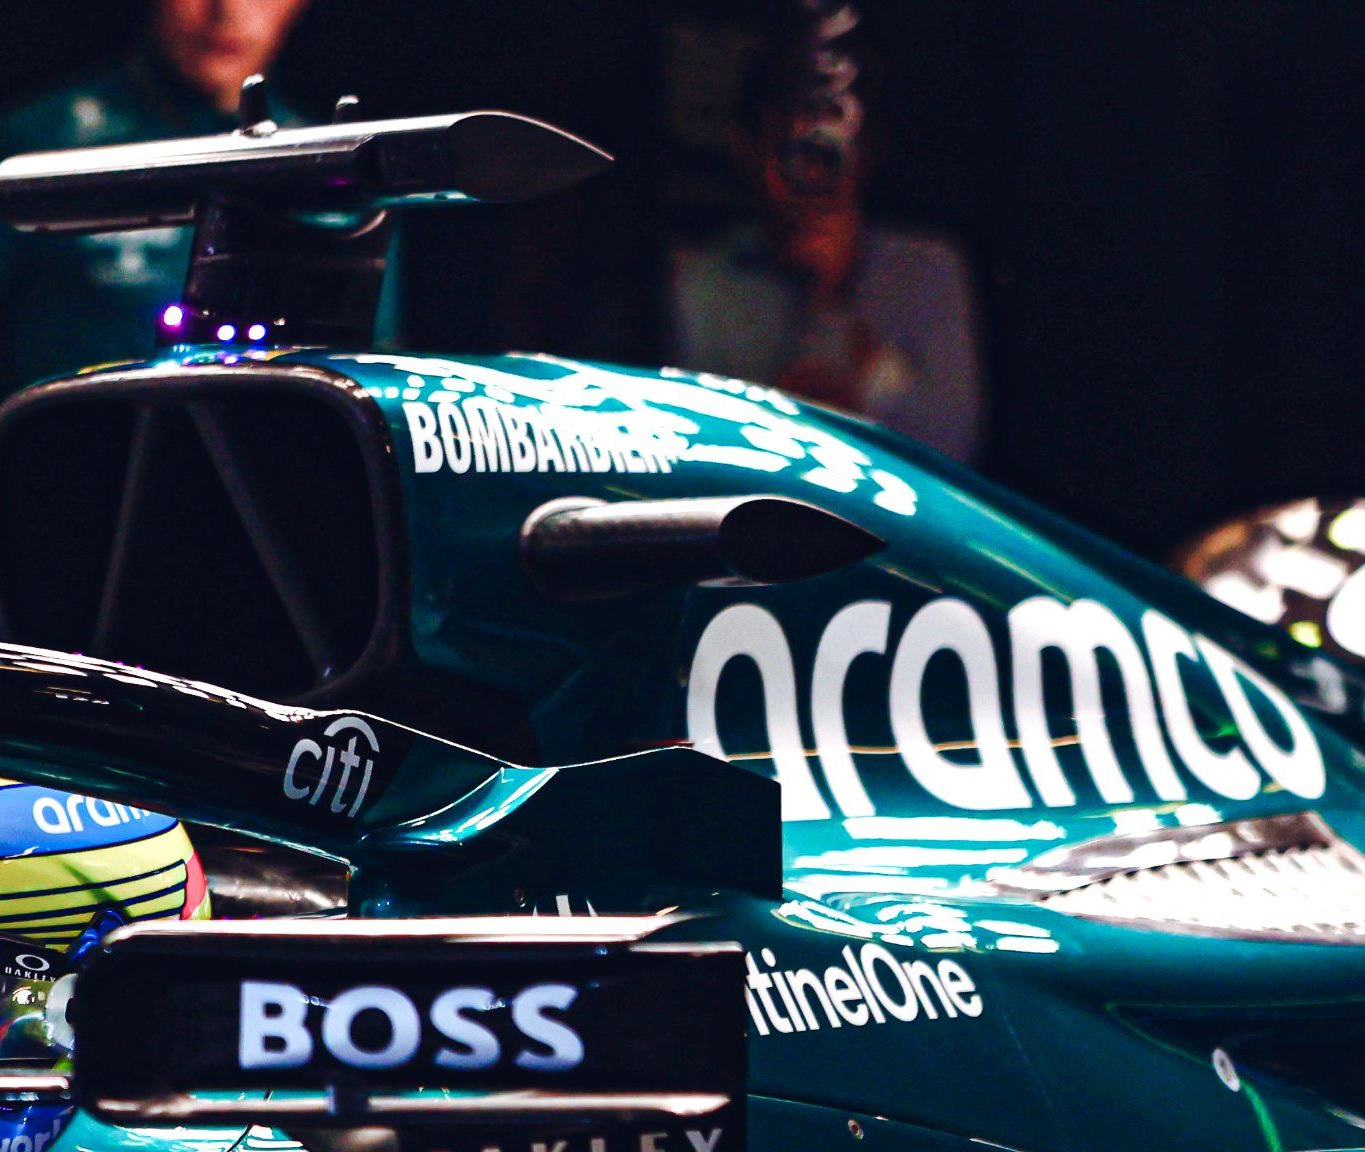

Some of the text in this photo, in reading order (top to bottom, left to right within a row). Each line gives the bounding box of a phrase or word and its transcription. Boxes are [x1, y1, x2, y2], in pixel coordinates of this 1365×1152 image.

[687, 596, 1327, 822] aramco
[283, 732, 376, 818] citi
[238, 980, 586, 1071] BOSS
